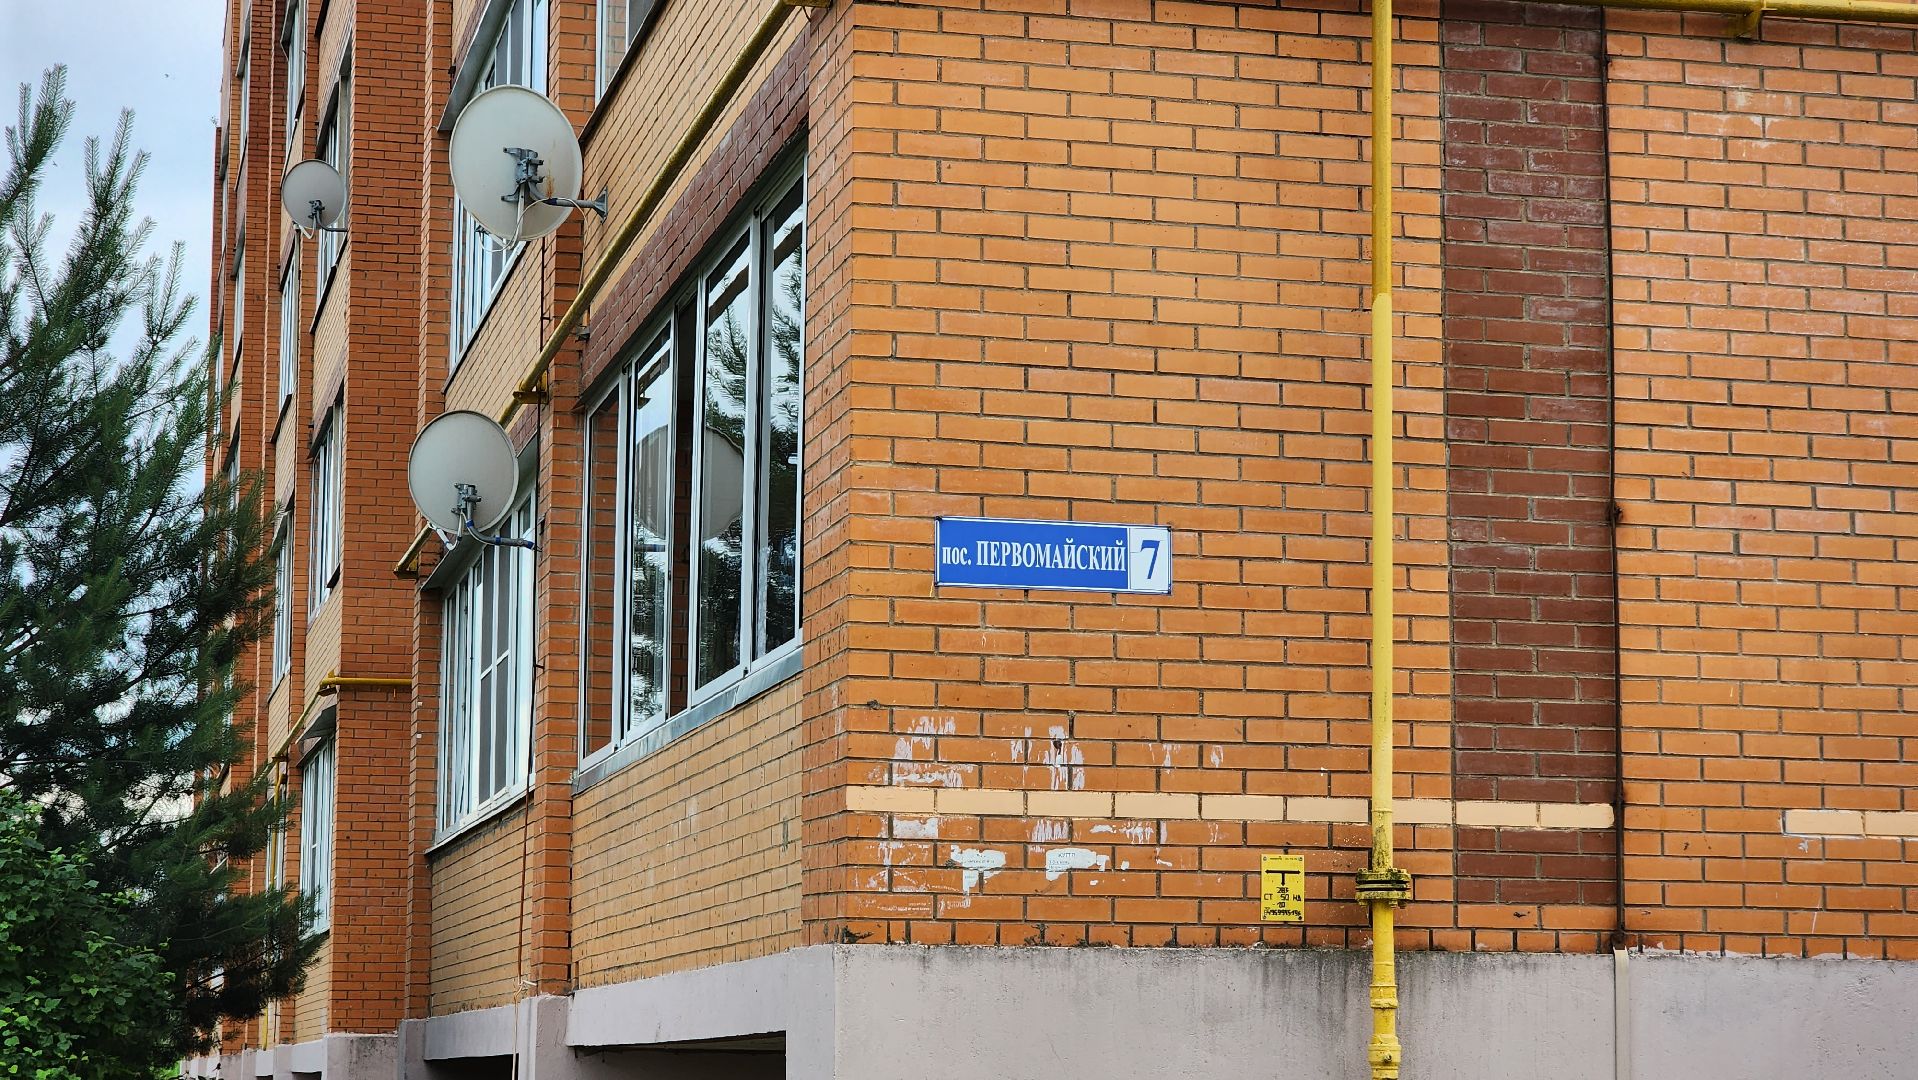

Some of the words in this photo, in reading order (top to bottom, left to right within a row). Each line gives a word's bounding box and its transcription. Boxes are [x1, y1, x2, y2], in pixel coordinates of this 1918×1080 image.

[942, 546, 972, 566] пос.
[976, 538, 1126, 572] ПЕРВОМАЙСКИЙ
[1140, 539, 1160, 579] 7
